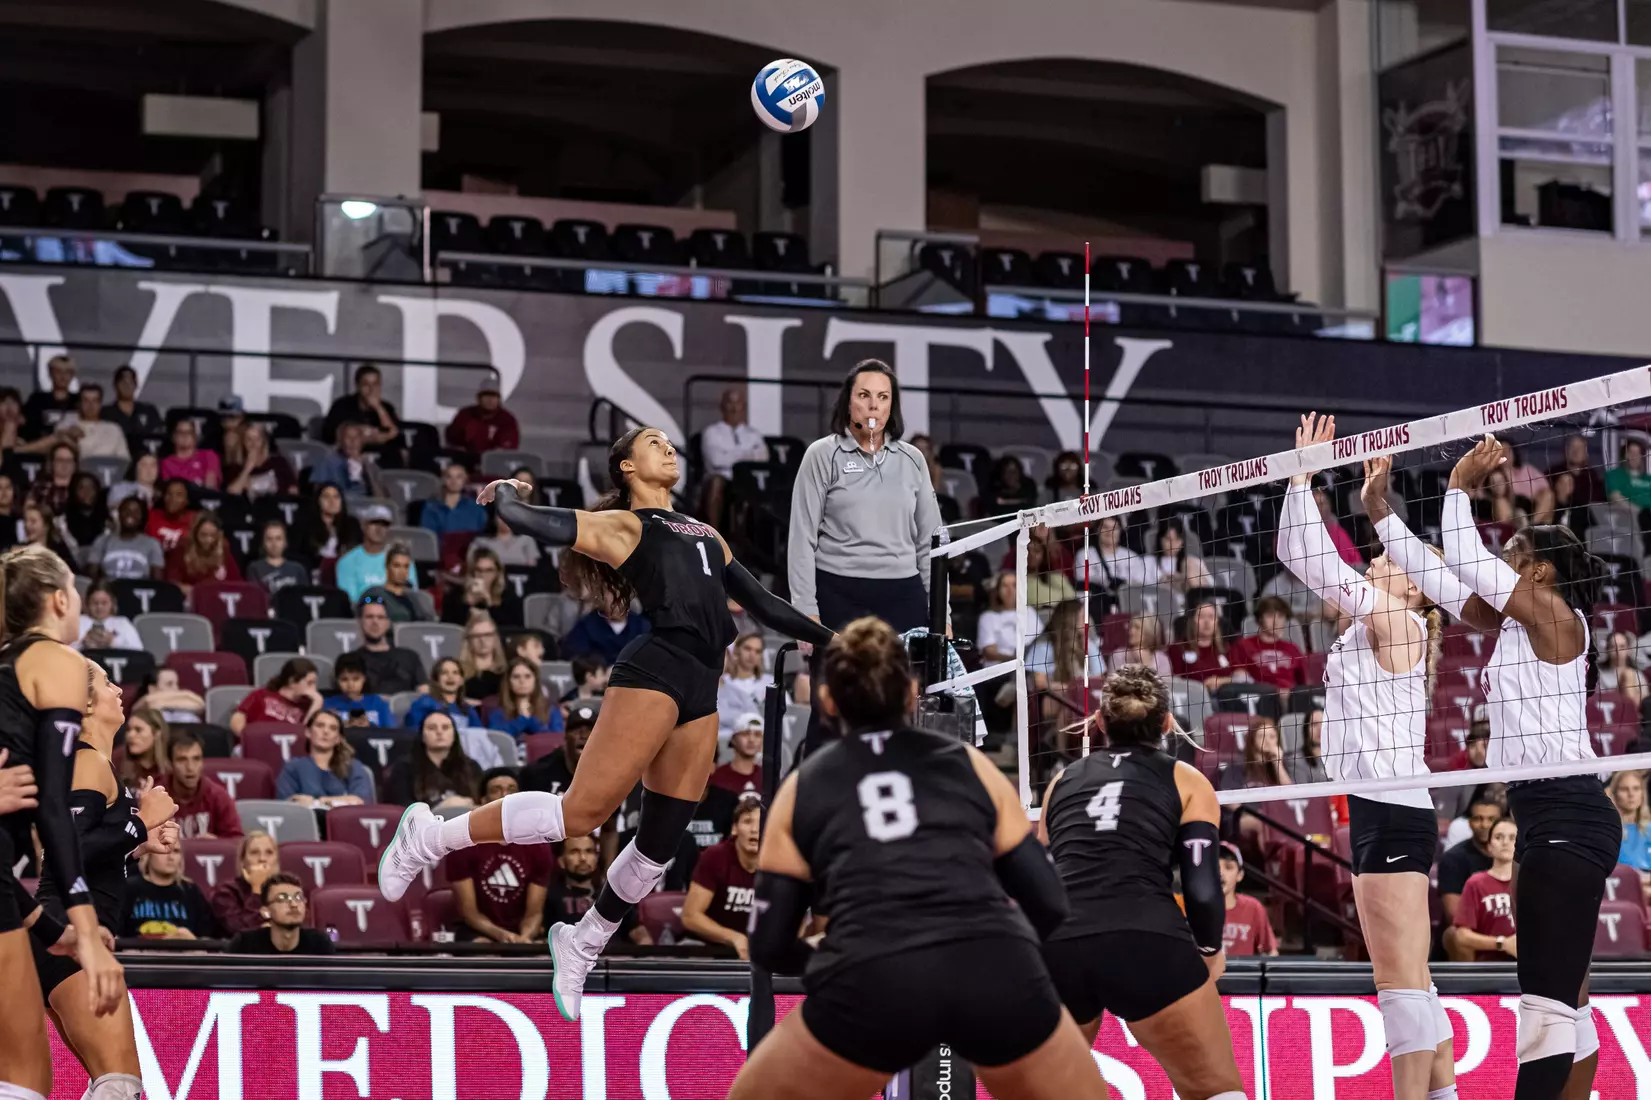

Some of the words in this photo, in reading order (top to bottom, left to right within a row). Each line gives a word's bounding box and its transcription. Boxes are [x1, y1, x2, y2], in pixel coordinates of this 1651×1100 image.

[788, 81, 821, 106] molten
[1481, 401, 1509, 426] TROY
[1515, 387, 1567, 418] TROJANS
[1332, 437, 1357, 460] TROY
[1361, 424, 1410, 451] TROJANS
[1199, 468, 1222, 490] TROY
[1226, 457, 1268, 481] TROJANS
[1103, 486, 1141, 511] TROJANS
[662, 520, 714, 538] TROY
[696, 541, 712, 577] 1
[54, 721, 81, 757] T
[857, 771, 918, 842] 8
[1085, 781, 1124, 831] 4
[1183, 839, 1212, 866] T
[1481, 893, 1511, 912] TR
